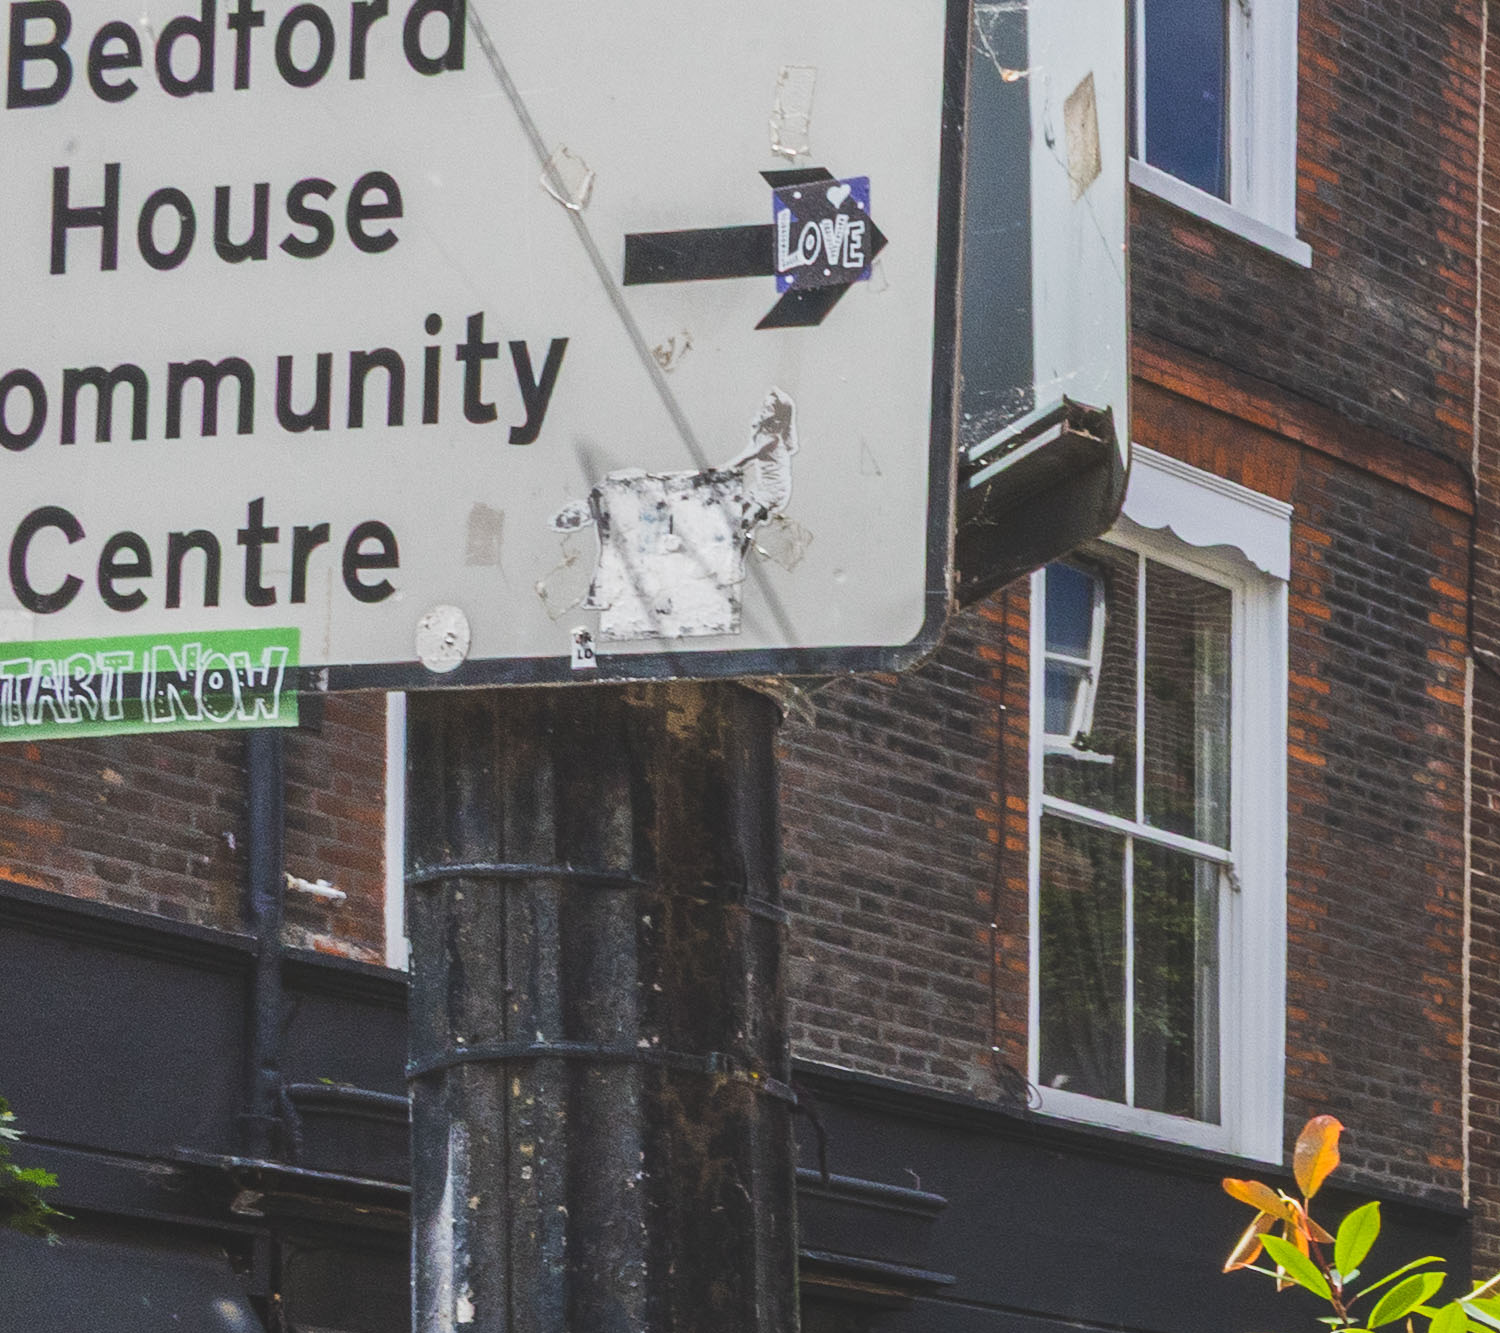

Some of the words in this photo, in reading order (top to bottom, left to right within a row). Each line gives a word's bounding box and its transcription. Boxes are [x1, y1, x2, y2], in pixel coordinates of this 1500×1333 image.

[49, 162, 403, 274] House
[777, 208, 865, 269] LOVE
[0, 309, 569, 450] ommunity
[7, 497, 401, 614] Centre
[0, 651, 133, 726] TART
[148, 642, 289, 724] NOW
